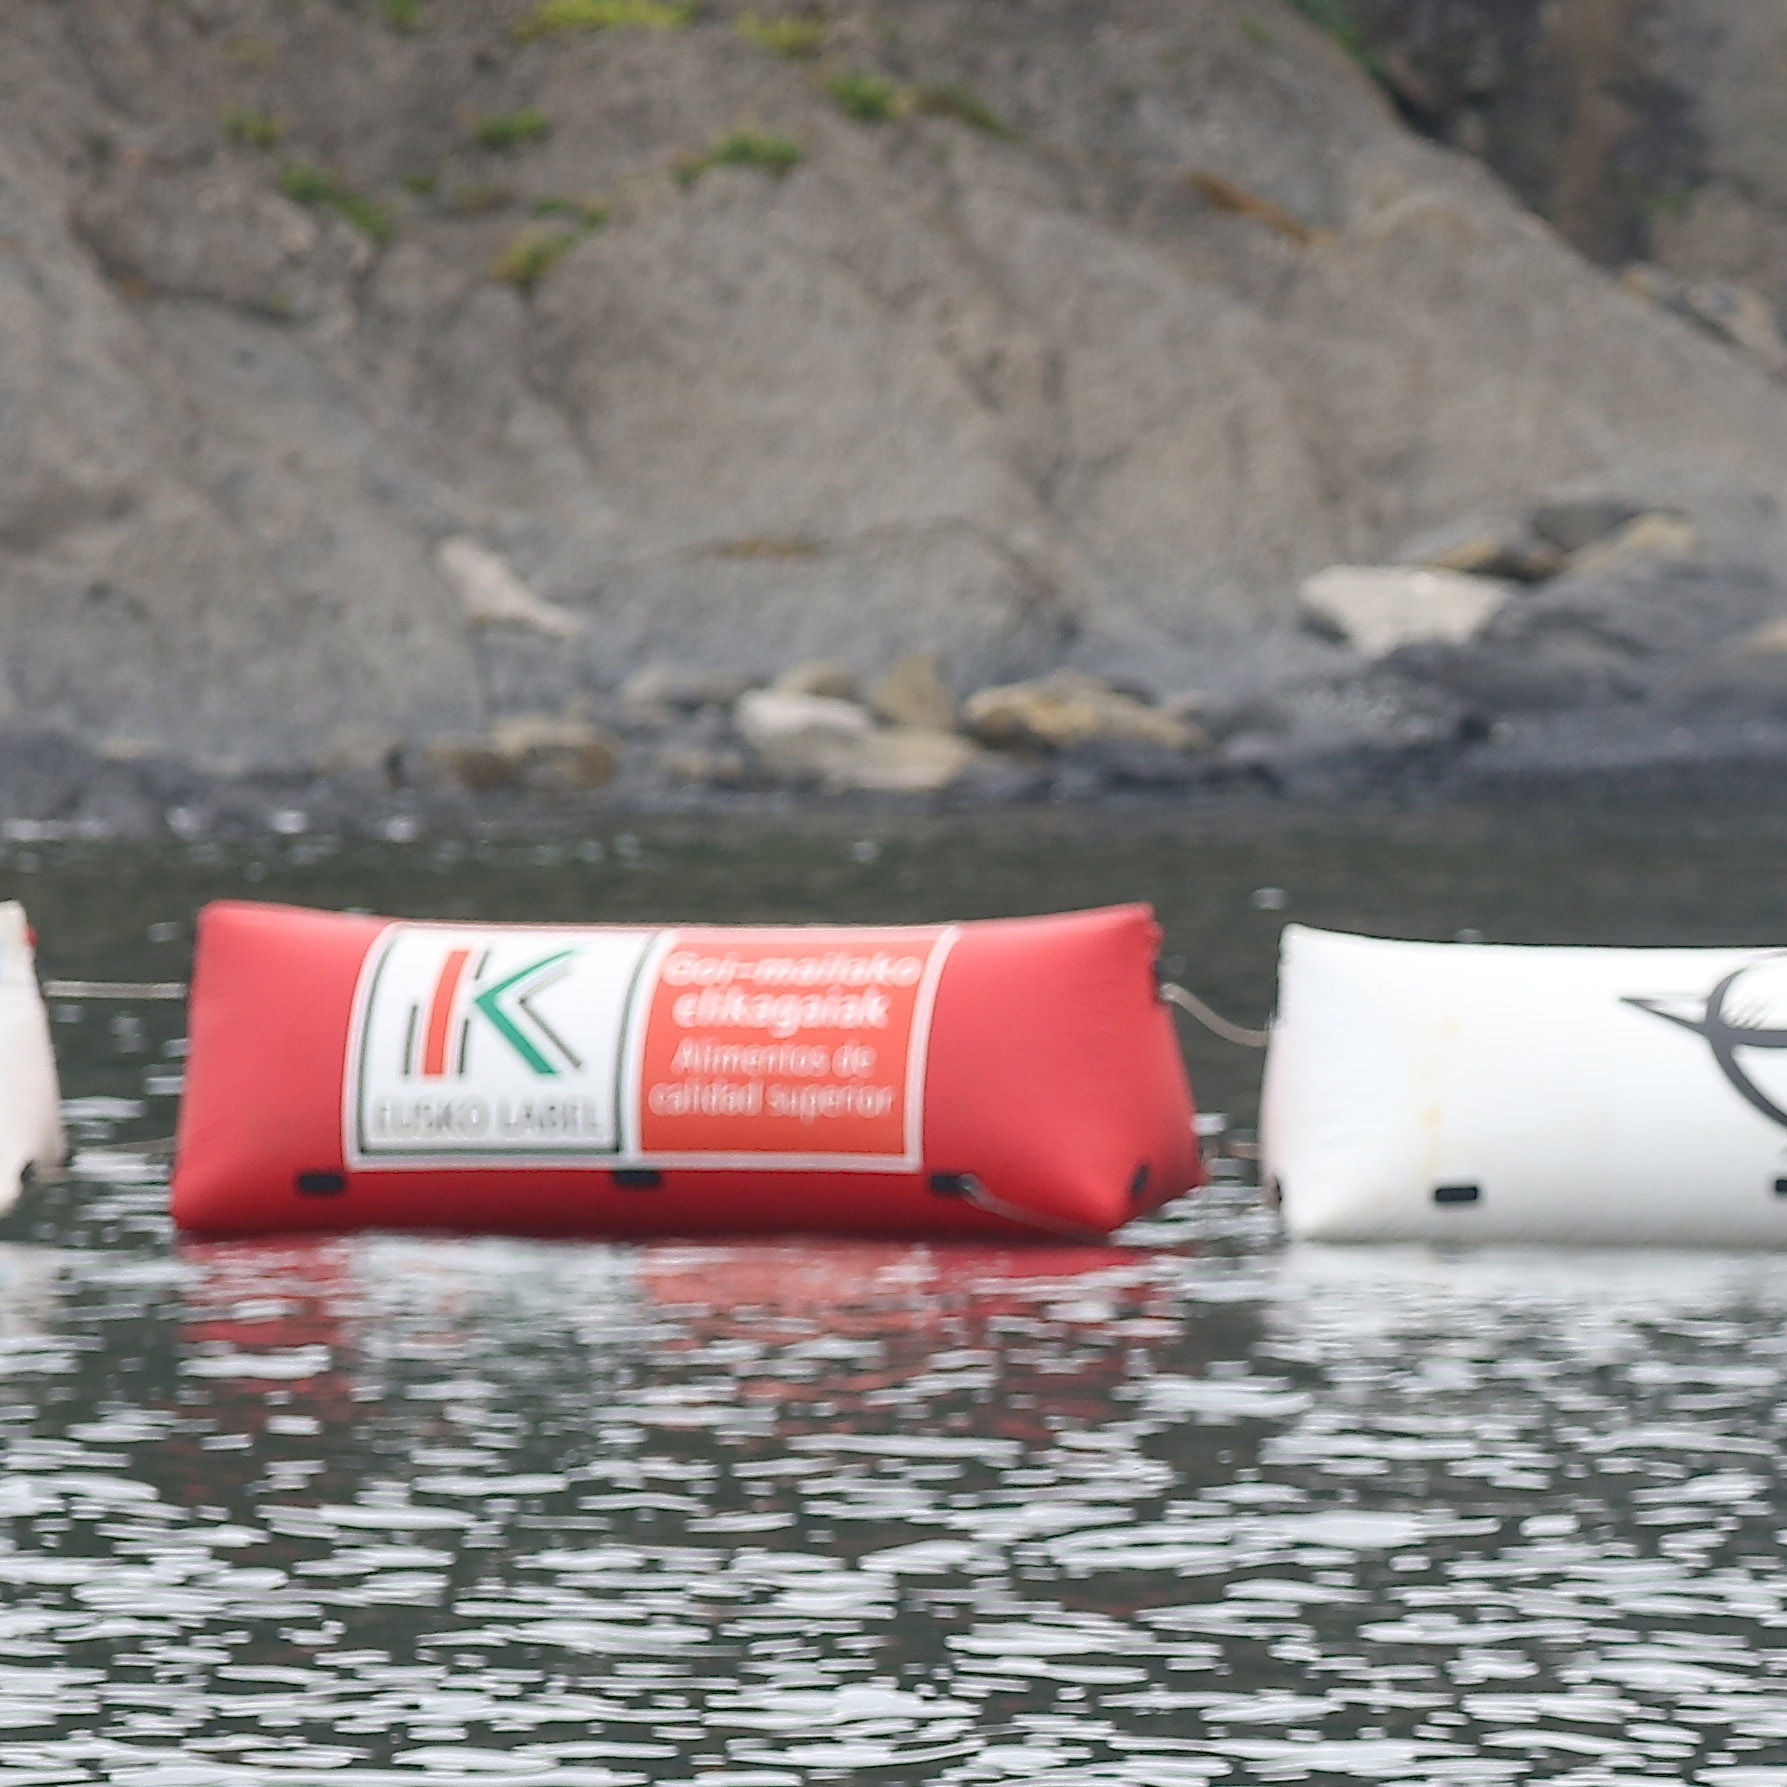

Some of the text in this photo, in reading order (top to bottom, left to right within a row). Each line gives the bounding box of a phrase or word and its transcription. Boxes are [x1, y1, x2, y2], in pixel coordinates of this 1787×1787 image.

[672, 986, 890, 1036] elikagaiak
[671, 1037, 877, 1077] Alimentos de
[649, 1078, 895, 1124] calidad superior
